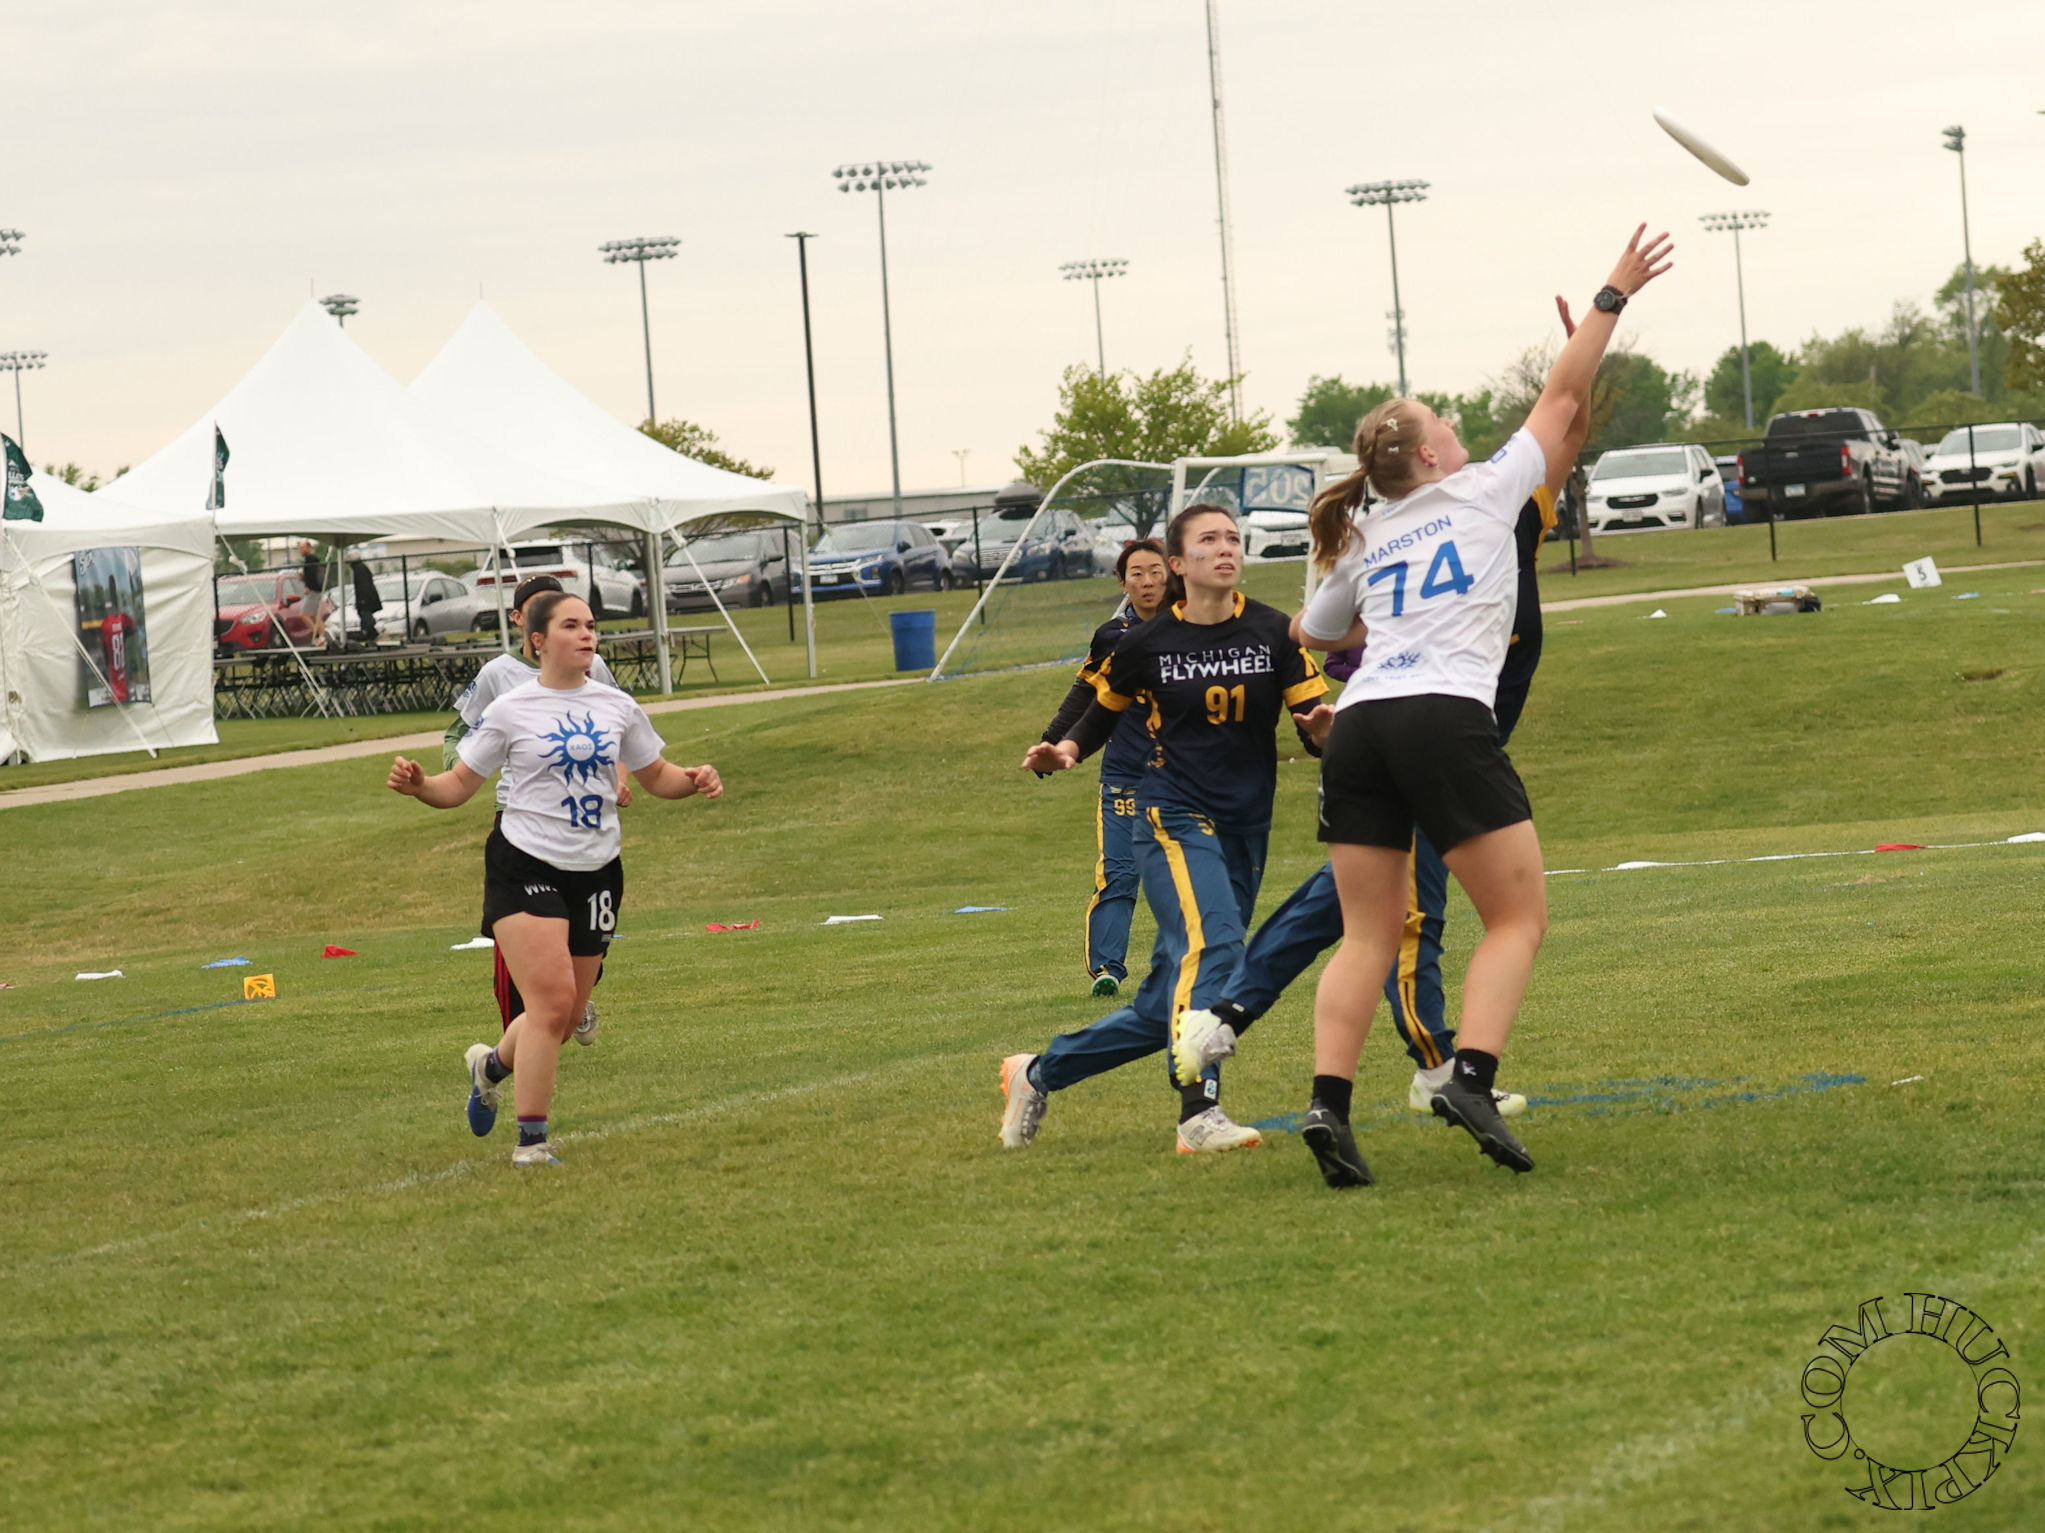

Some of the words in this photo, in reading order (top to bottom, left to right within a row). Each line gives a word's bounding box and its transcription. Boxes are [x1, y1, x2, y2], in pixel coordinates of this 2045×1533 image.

[1363, 515, 1453, 568] MARSTON
[1367, 540, 1475, 617] 74
[1158, 644, 1272, 667] MICHIGAN
[1160, 654, 1275, 684] FLYWHEEL
[1204, 683, 1246, 725] 91
[560, 794, 604, 829] 18
[587, 890, 616, 932] 18
